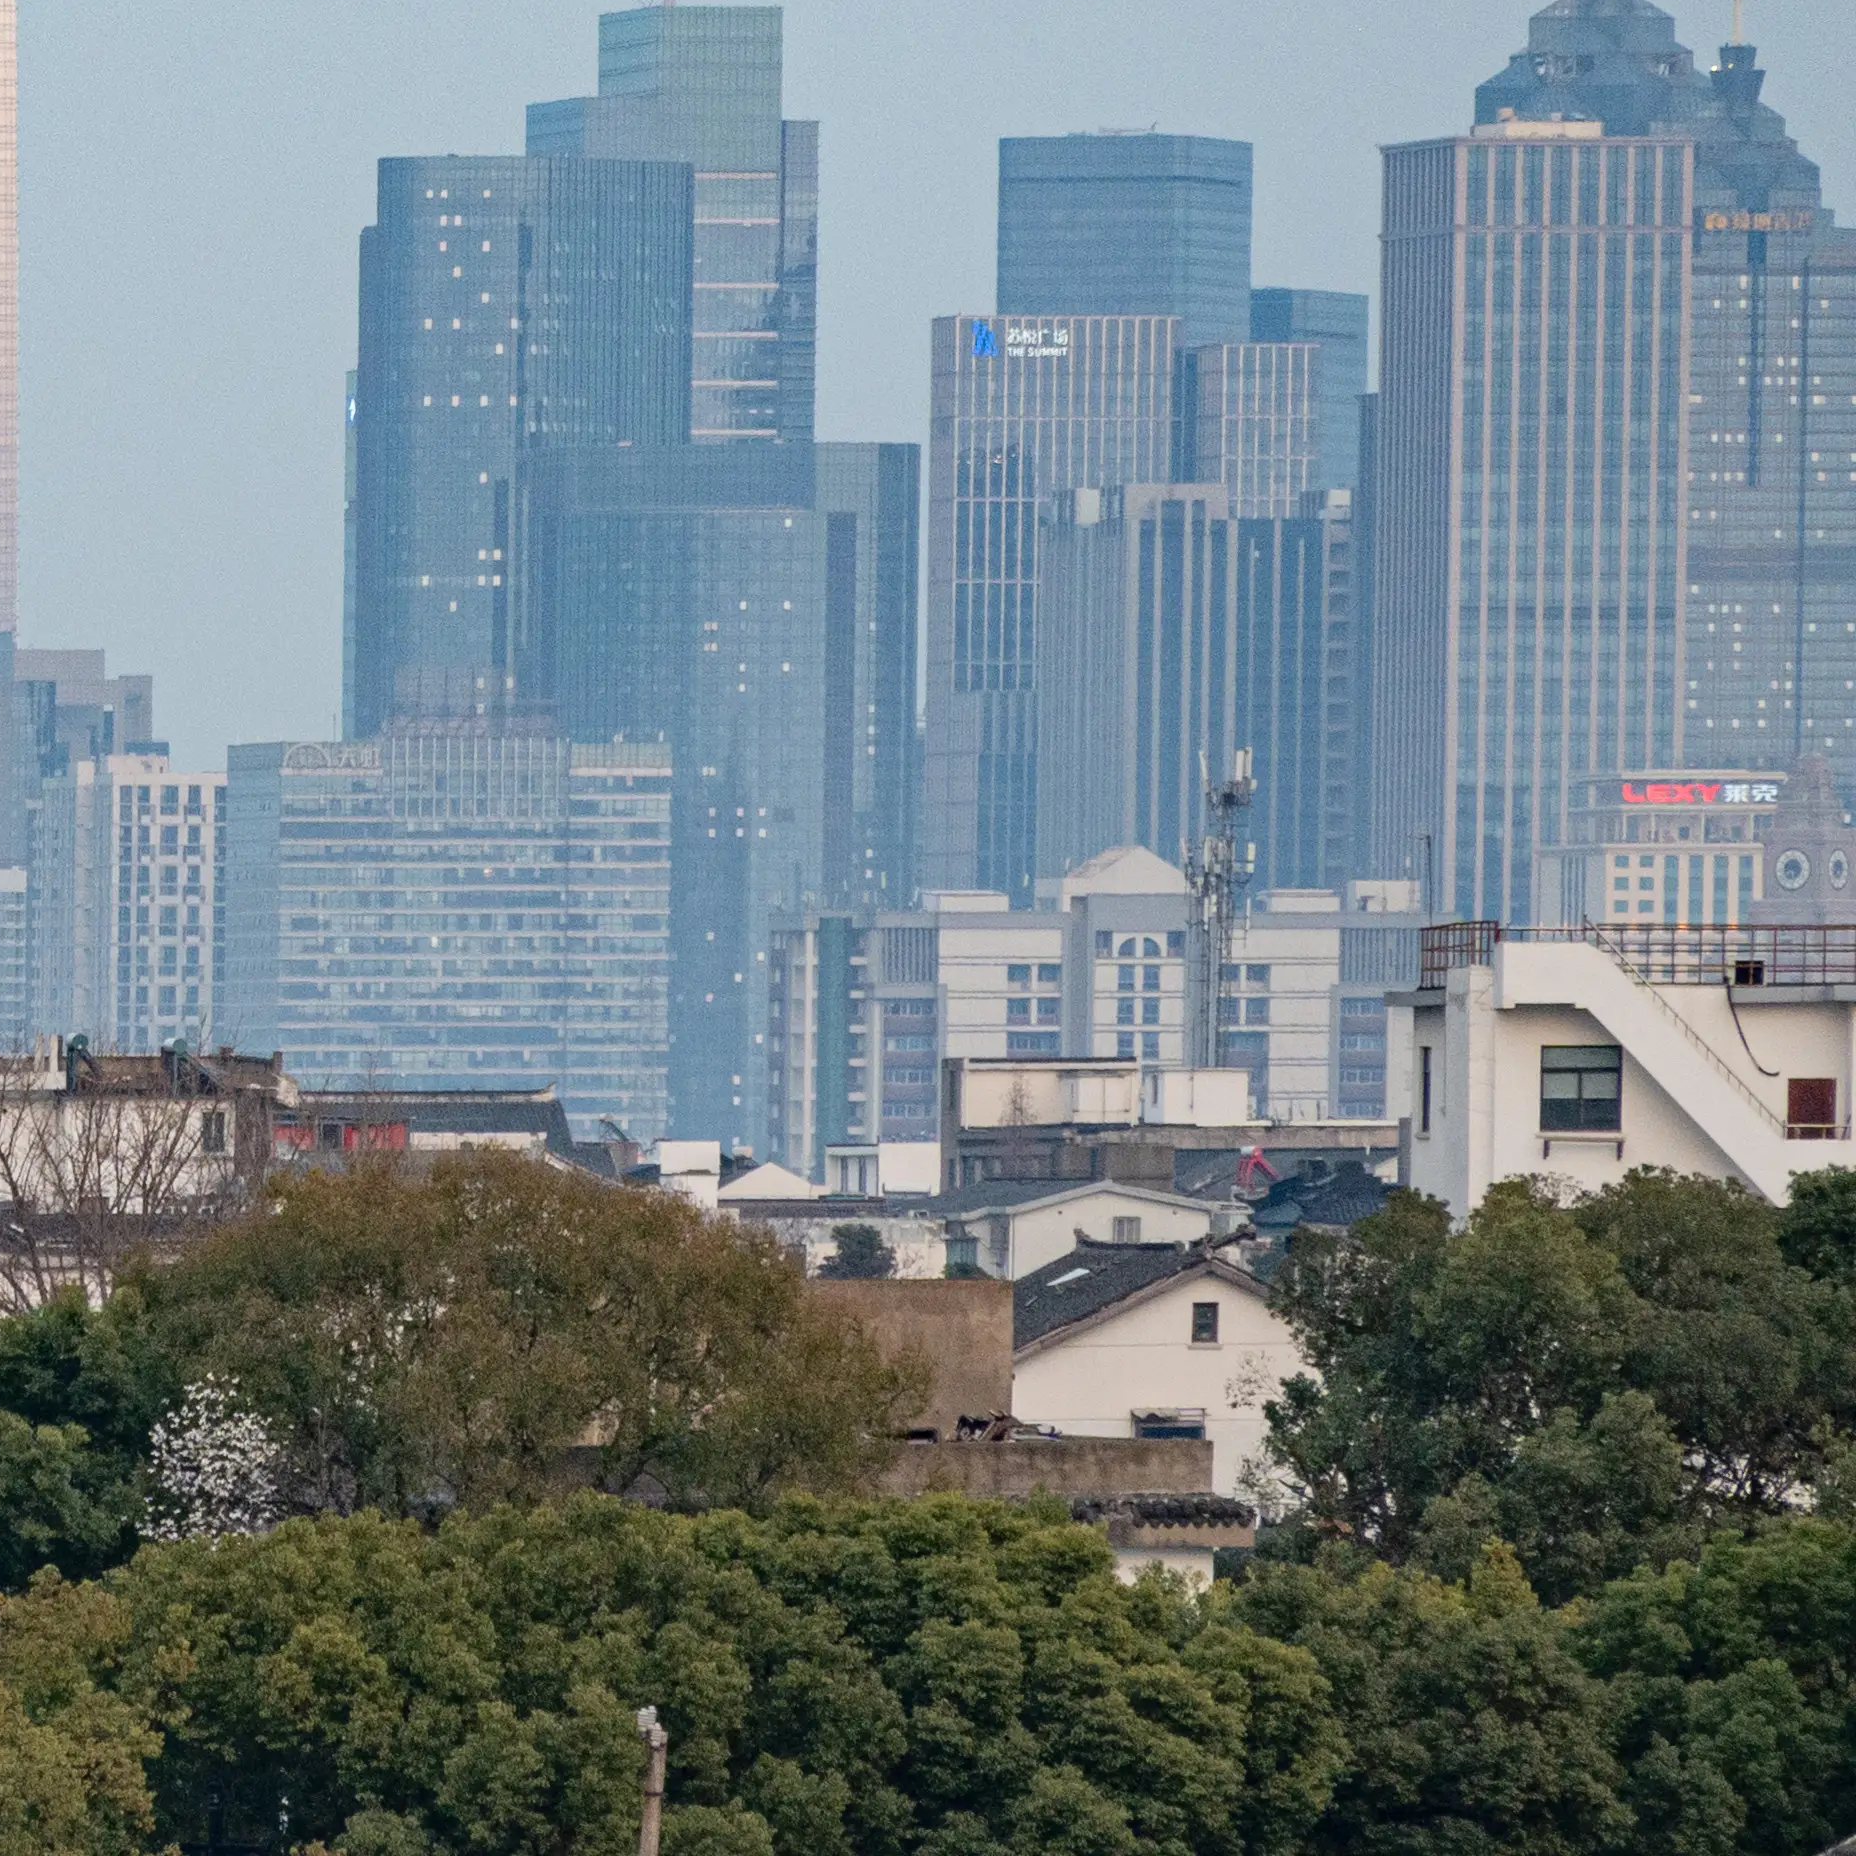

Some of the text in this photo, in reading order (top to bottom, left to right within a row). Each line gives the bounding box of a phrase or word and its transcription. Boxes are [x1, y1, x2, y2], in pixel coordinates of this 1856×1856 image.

[1008, 347, 1068, 357] THE SUMMIT
[1622, 783, 1777, 803] LEXY 莱克
